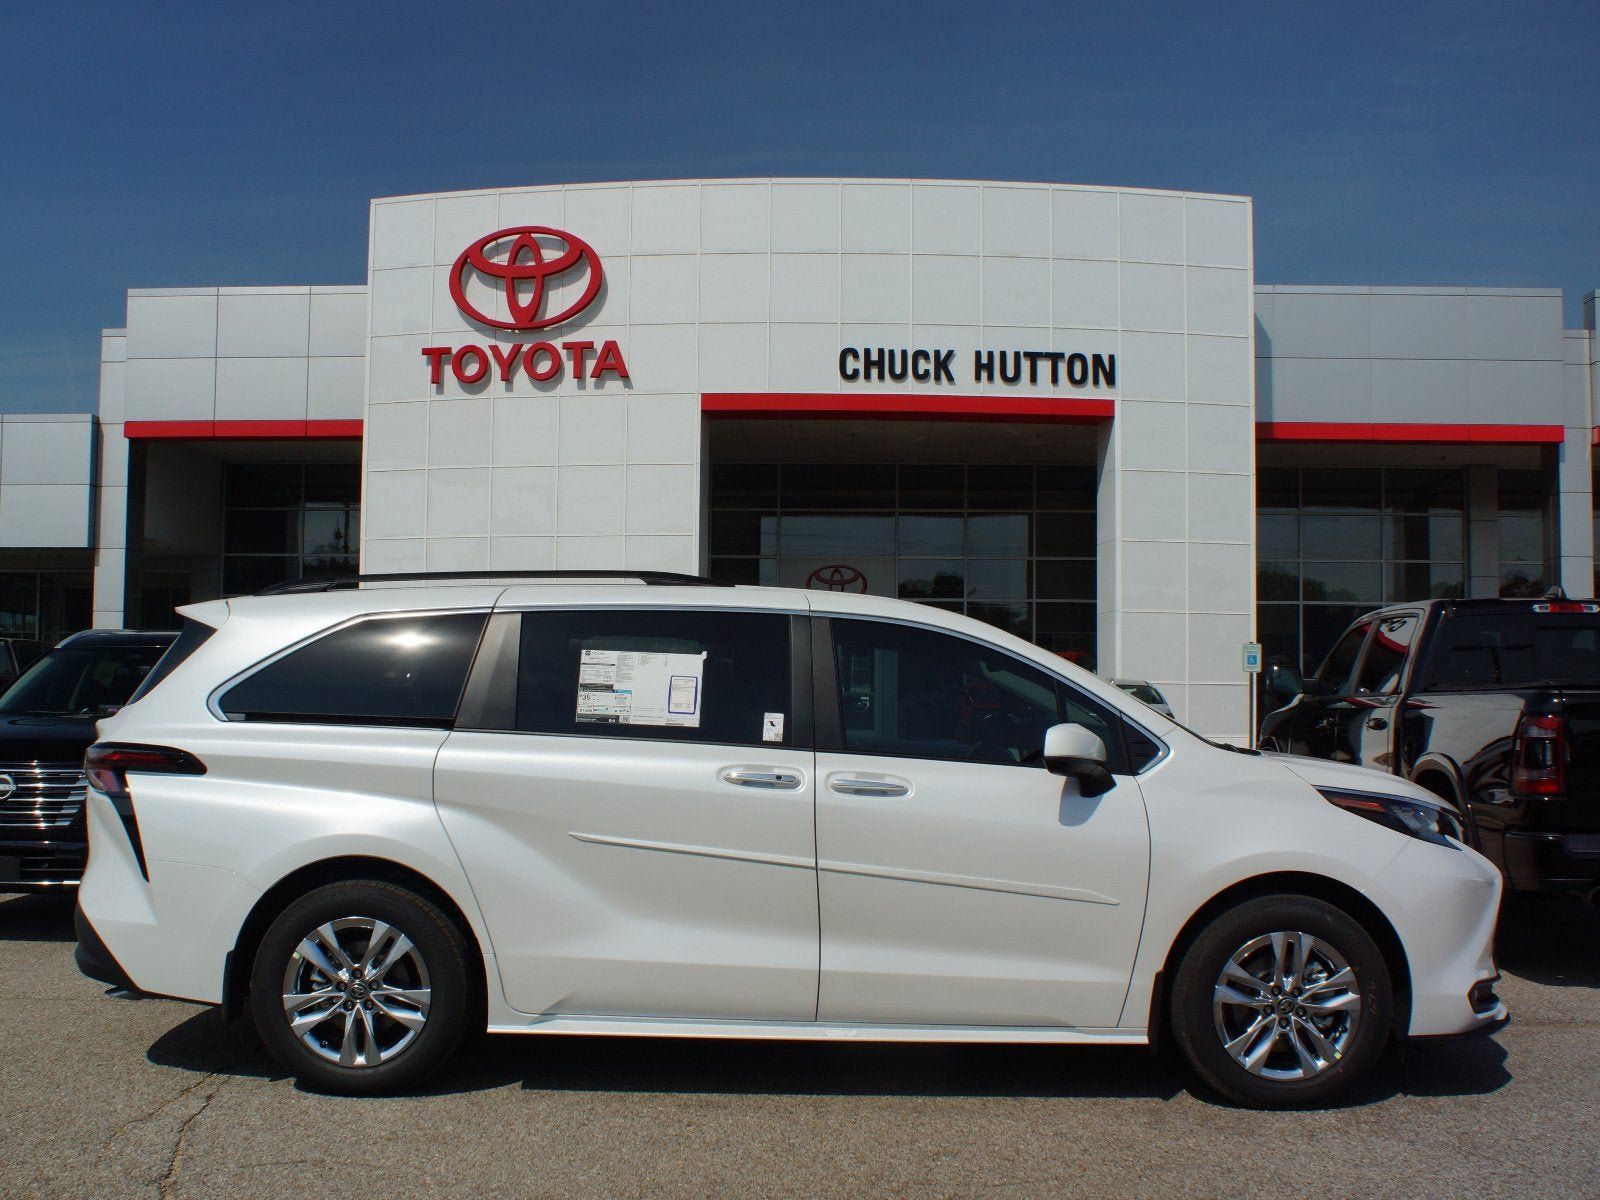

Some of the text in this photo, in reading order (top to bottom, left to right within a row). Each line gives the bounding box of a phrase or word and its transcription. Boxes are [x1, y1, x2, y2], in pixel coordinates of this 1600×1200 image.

[422, 340, 630, 385] TOYOTA
[839, 347, 1116, 386] CHUCK HUTTON
